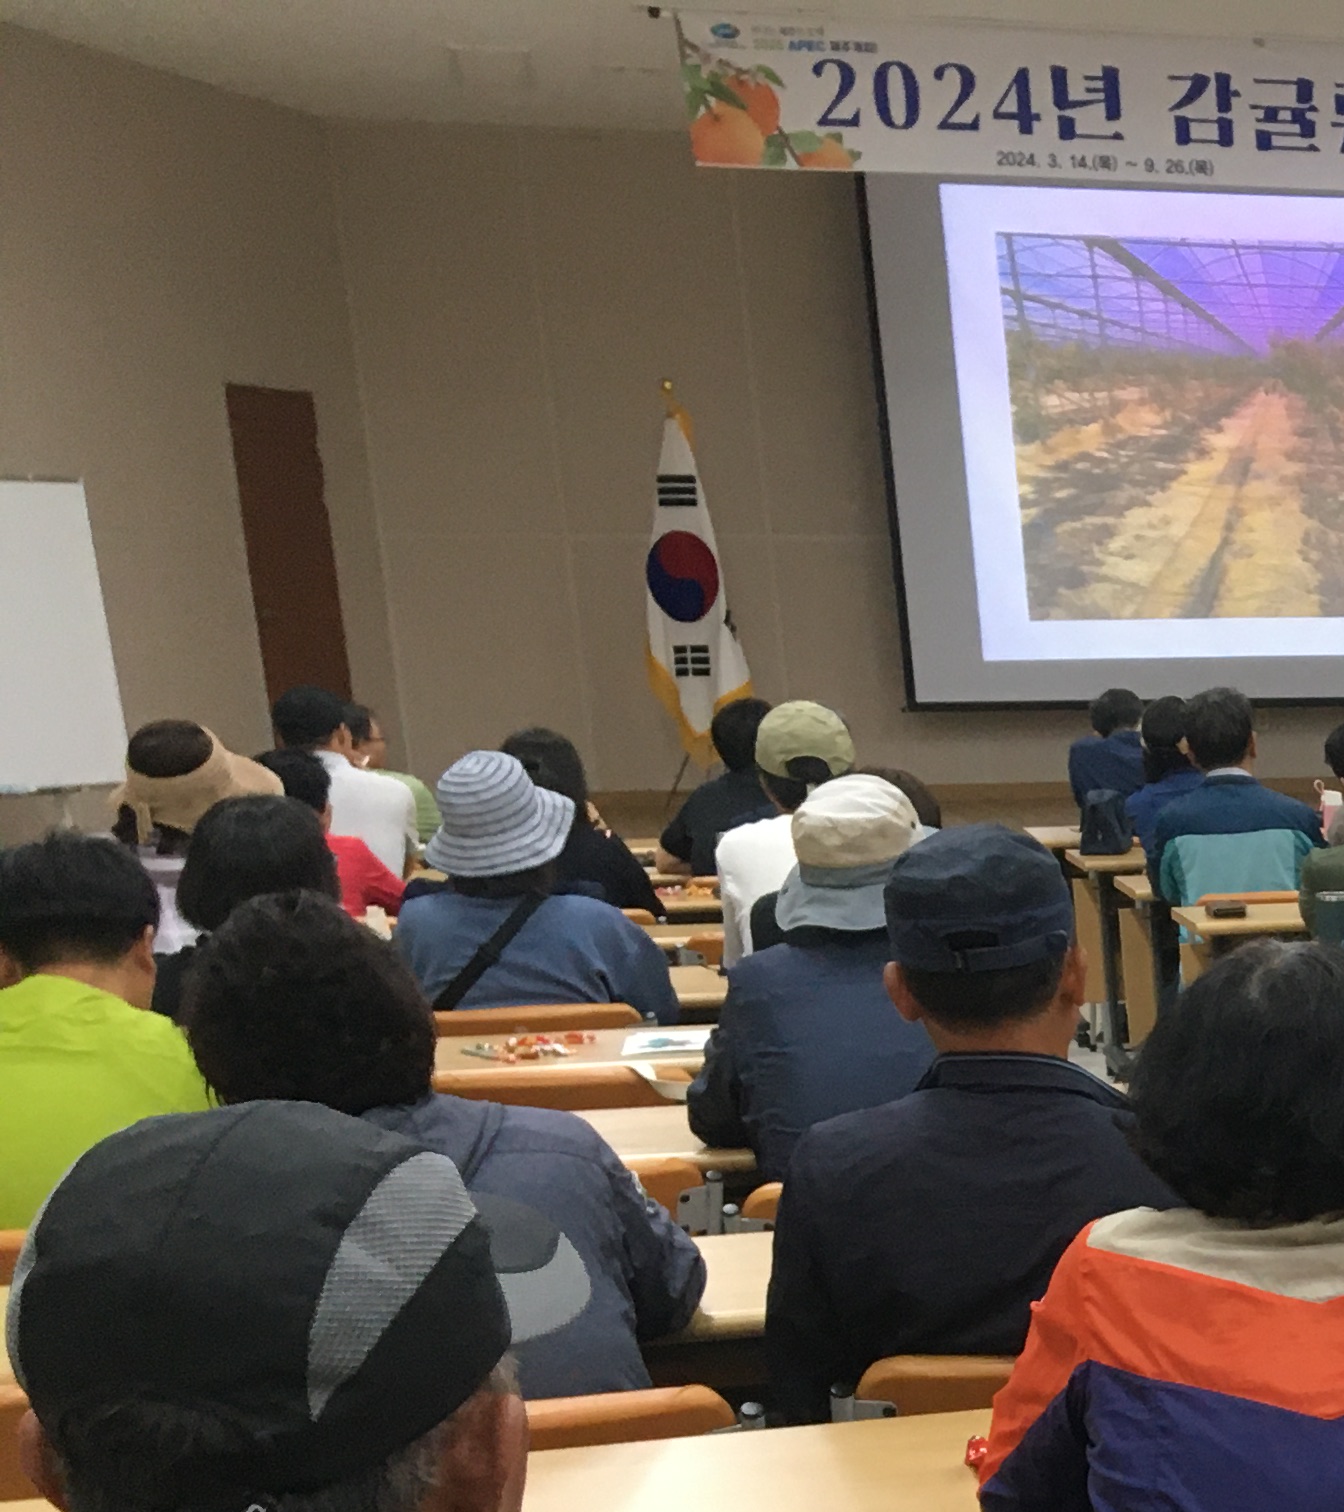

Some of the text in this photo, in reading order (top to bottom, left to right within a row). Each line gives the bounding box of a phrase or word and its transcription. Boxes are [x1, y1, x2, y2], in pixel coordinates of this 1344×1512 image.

[811, 57, 1125, 142] 2024년
[996, 150, 1041, 169] 2024.
[1047, 154, 1063, 170] 3.
[1144, 157, 1160, 174] 9.
